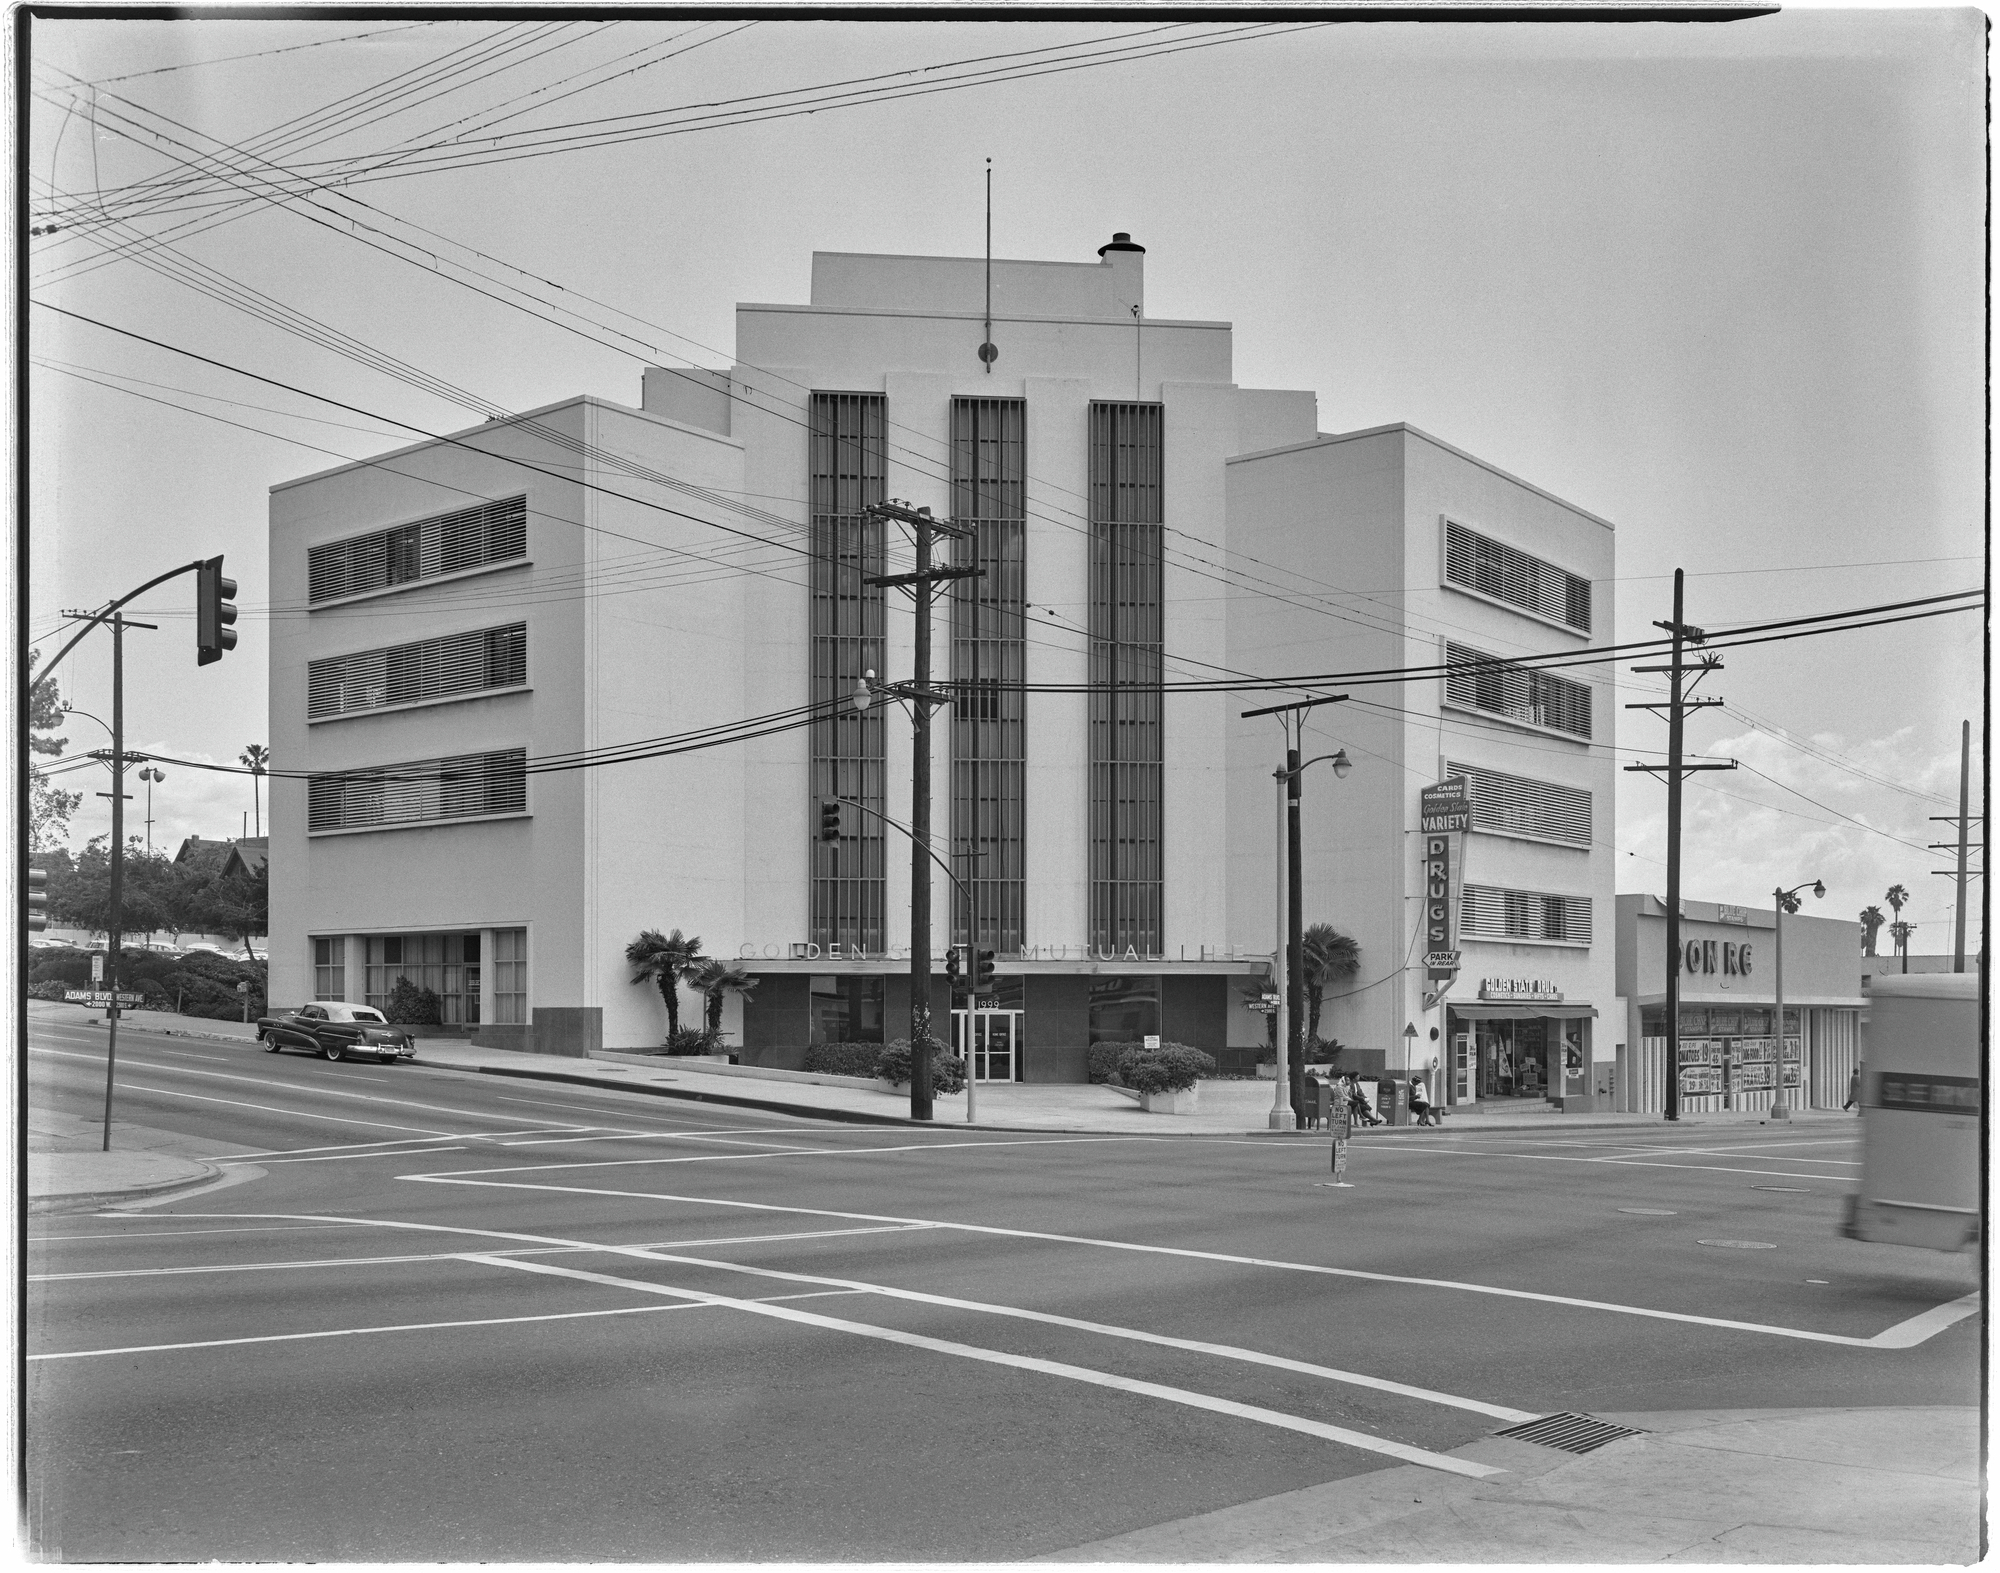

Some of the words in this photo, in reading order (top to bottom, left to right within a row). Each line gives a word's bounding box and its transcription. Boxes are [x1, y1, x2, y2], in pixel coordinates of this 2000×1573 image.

[1423, 803, 1449, 815] Golden
[1422, 814, 1468, 831] VARIETY
[1430, 840, 1447, 941] DRUGS
[740, 943, 867, 960] GOLDEN
[1020, 944, 1160, 961] MUTUAL
[1181, 944, 1245, 962] LIFE
[1484, 978, 1511, 992] GOLDEN
[1513, 979, 1533, 992] STATE
[65, 991, 91, 1000] ADAMS
[116, 993, 134, 1002] WESTERN
[978, 1001, 1000, 1009] 1999
[1679, 1049, 1700, 1062] OMATOES
